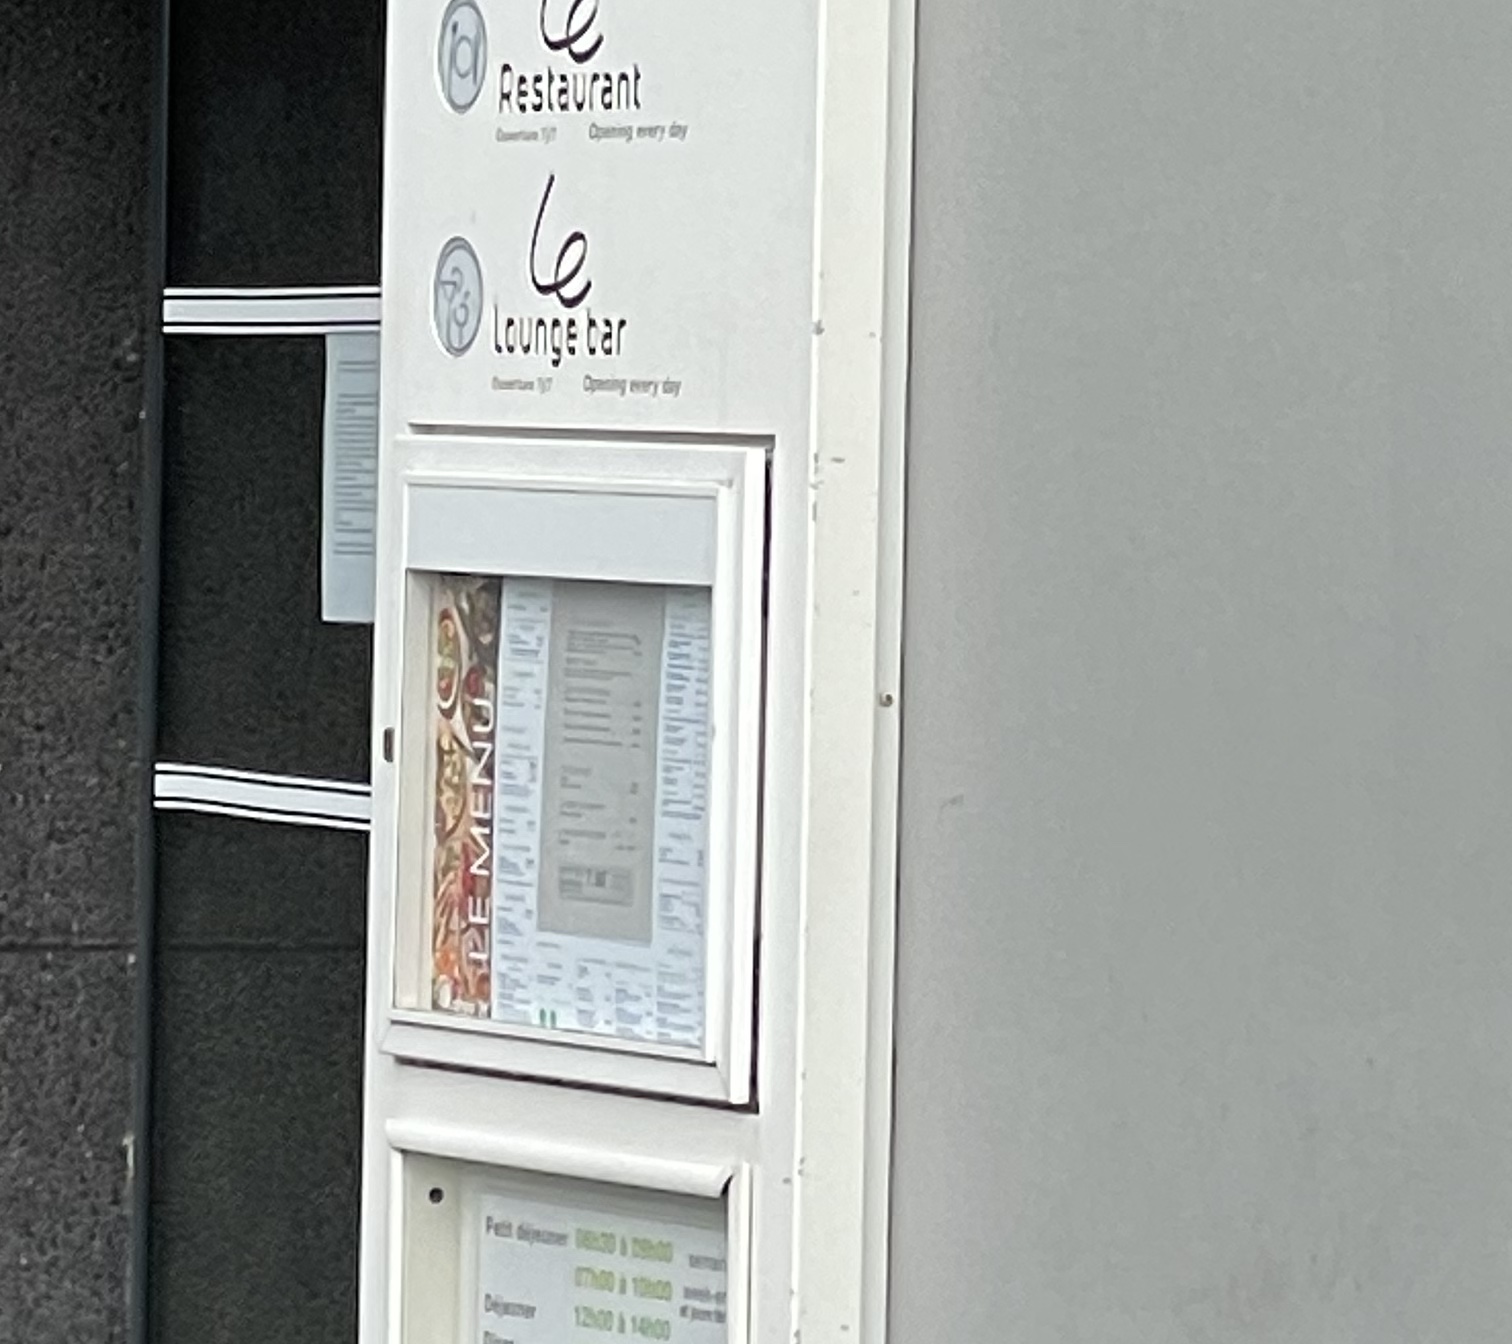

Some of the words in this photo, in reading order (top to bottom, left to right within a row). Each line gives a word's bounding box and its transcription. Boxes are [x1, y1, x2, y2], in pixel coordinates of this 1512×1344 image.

[498, 64, 641, 114] Restaurant
[589, 122, 633, 144] Opening
[636, 125, 666, 142] every
[669, 121, 688, 141] day
[492, 302, 578, 367] lounge
[586, 307, 627, 357] bar
[583, 374, 627, 396] Opening
[630, 379, 658, 397] every
[662, 377, 682, 398] day
[469, 698, 494, 877] MENU
